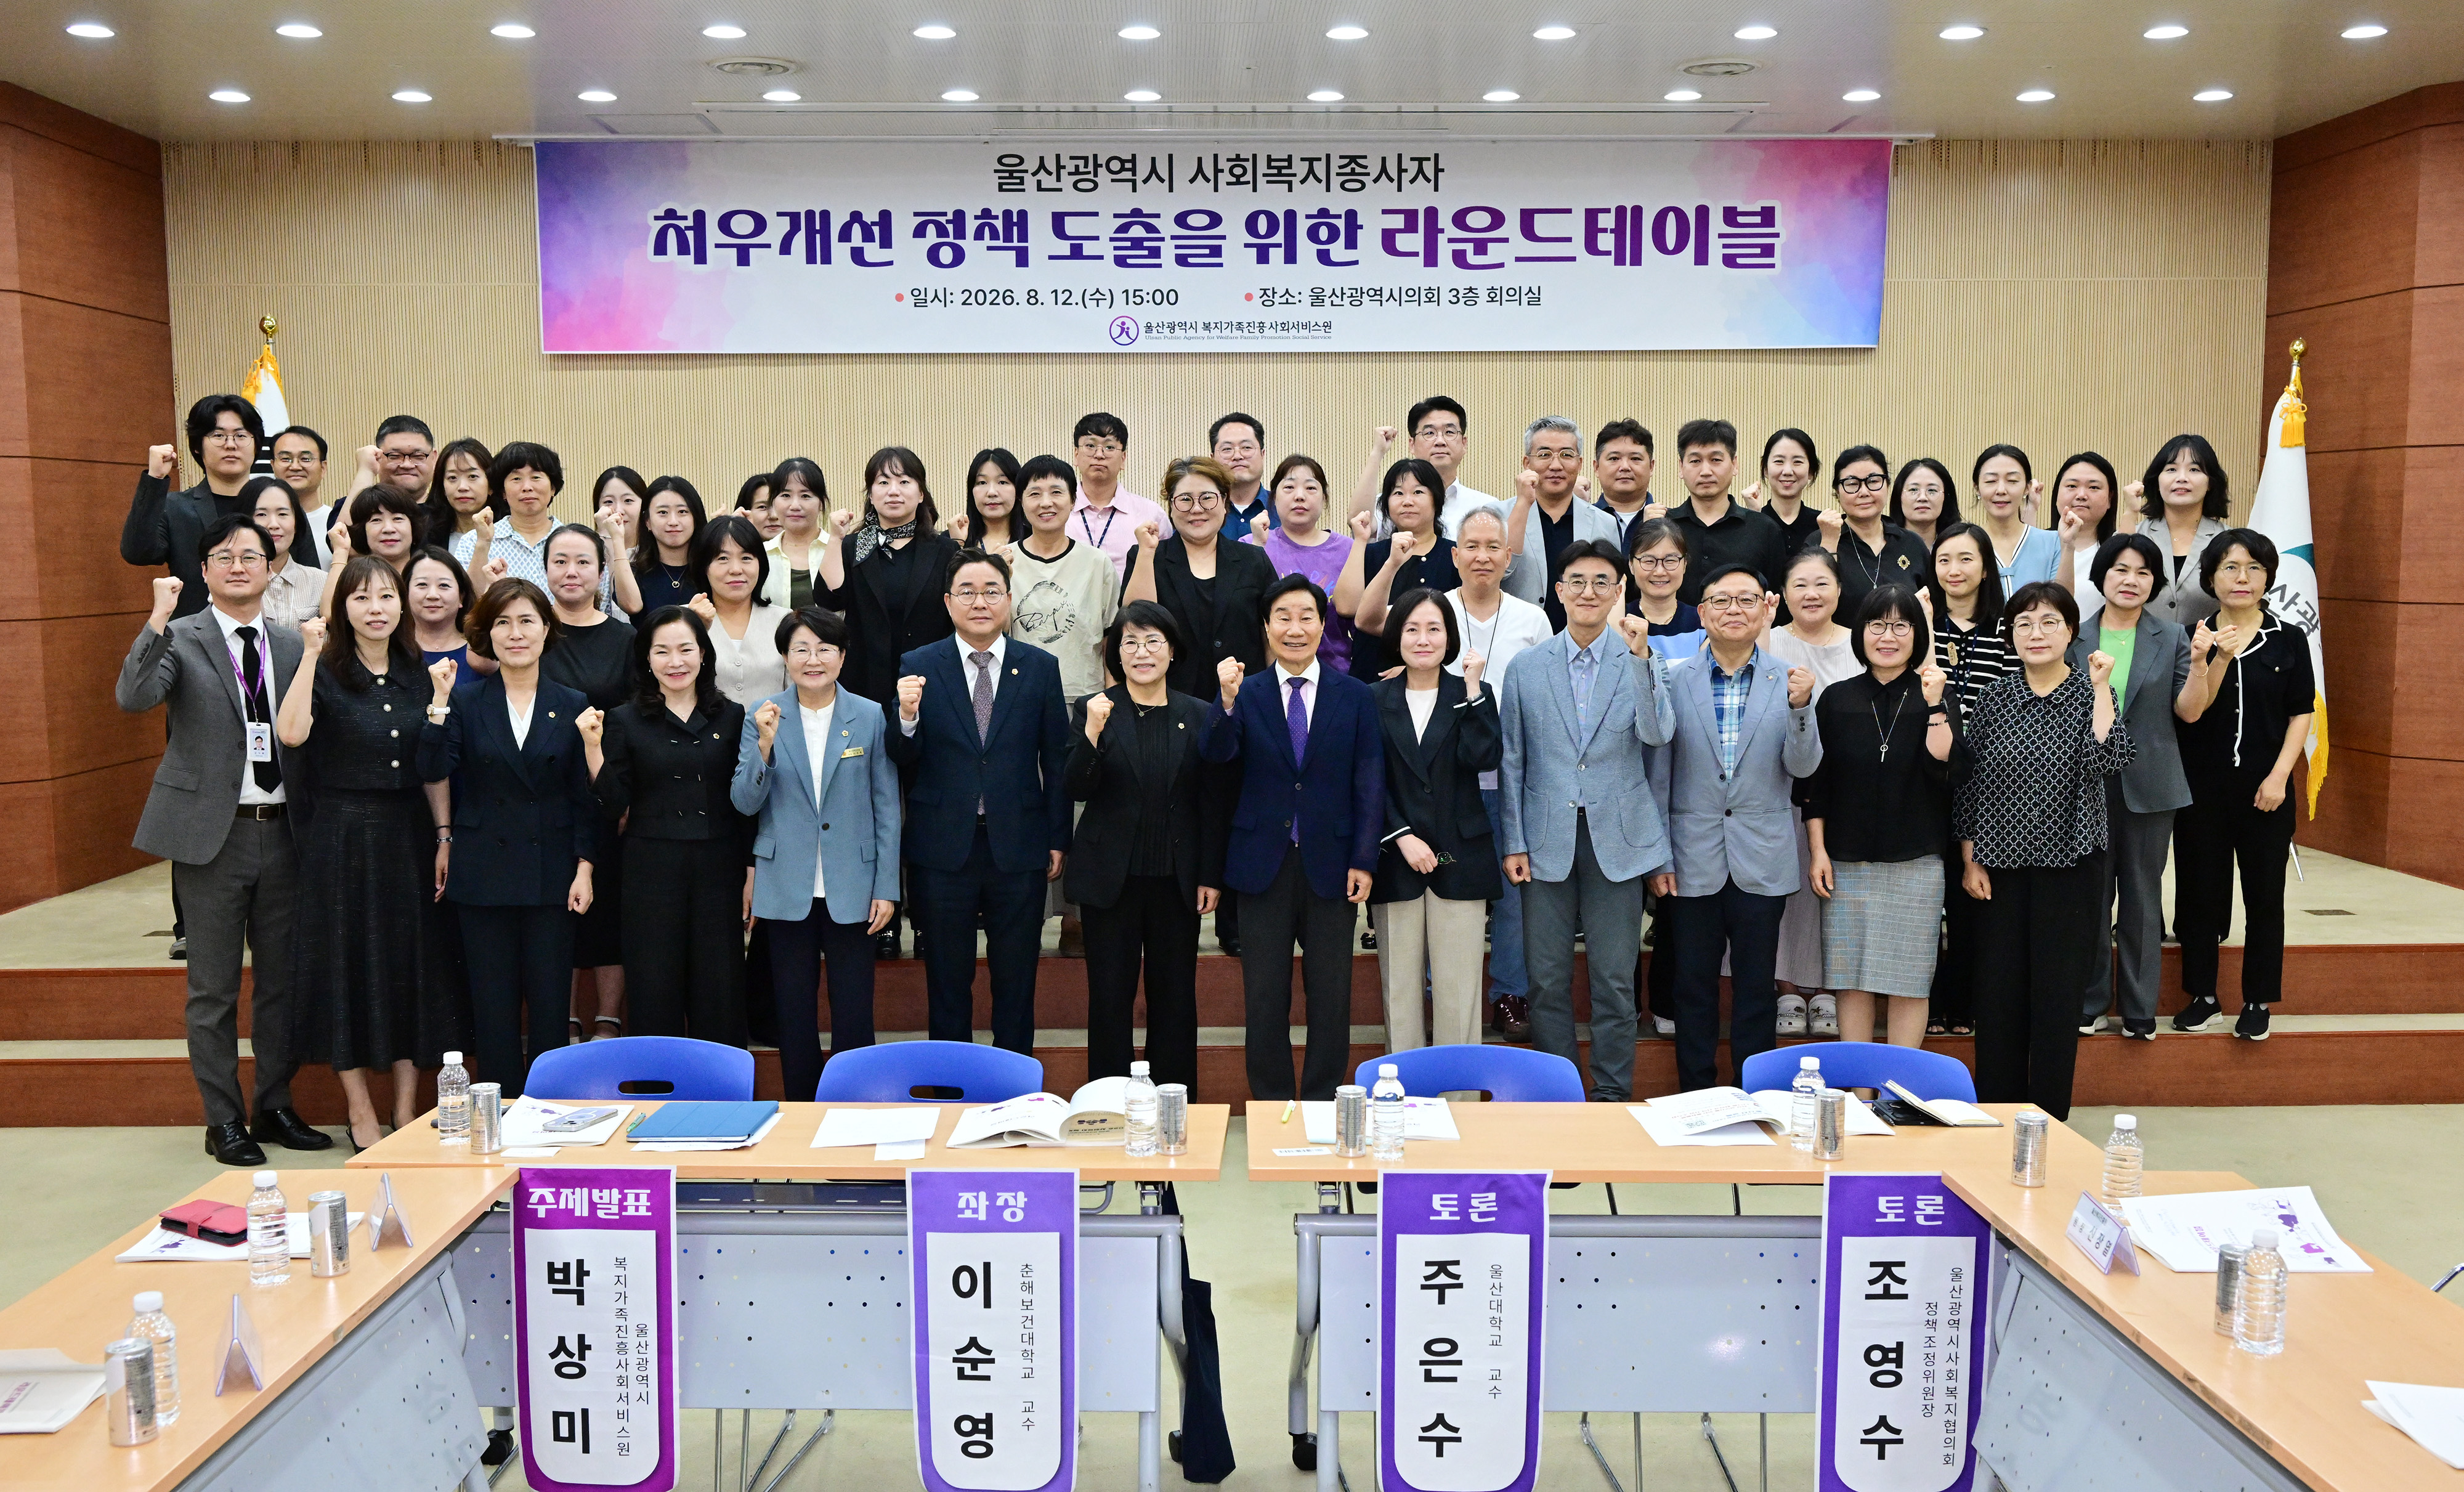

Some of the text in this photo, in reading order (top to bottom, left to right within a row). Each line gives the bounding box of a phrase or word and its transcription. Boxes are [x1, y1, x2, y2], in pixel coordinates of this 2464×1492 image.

[993, 153, 1445, 193] 울산광역시 사회복지종사자
[653, 204, 1780, 270] 처우개선 정책 도출을 위한 라운드테이블
[910, 287, 1179, 309] 일시: 2026. 8. 12.(수) 15:00
[1143, 321, 1198, 334] 울산광역시
[1258, 285, 1541, 307] 장소: 울산광역시의회 3층 회의실
[527, 1187, 652, 1219] 주제발표
[957, 1191, 1028, 1223] 좌장
[1429, 1192, 1498, 1223] 토론
[1875, 1195, 1945, 1225] 토론
[547, 1259, 592, 1454] 박상미
[614, 1257, 630, 1456] 복지가족진흥사회서비스원
[635, 1323, 649, 1405] 울산광역시
[952, 1262, 995, 1459] 이순영
[1020, 1263, 1035, 1430] 춘해보건대학교 교수
[1418, 1260, 1464, 1458] 주은수
[1488, 1264, 1503, 1399] 울산대학교 교수
[1860, 1261, 1908, 1461] 조영수
[1921, 1302, 1938, 1417] 정책조정위원장
[1942, 1267, 1964, 1467] 울산광역시사회복지협의회
